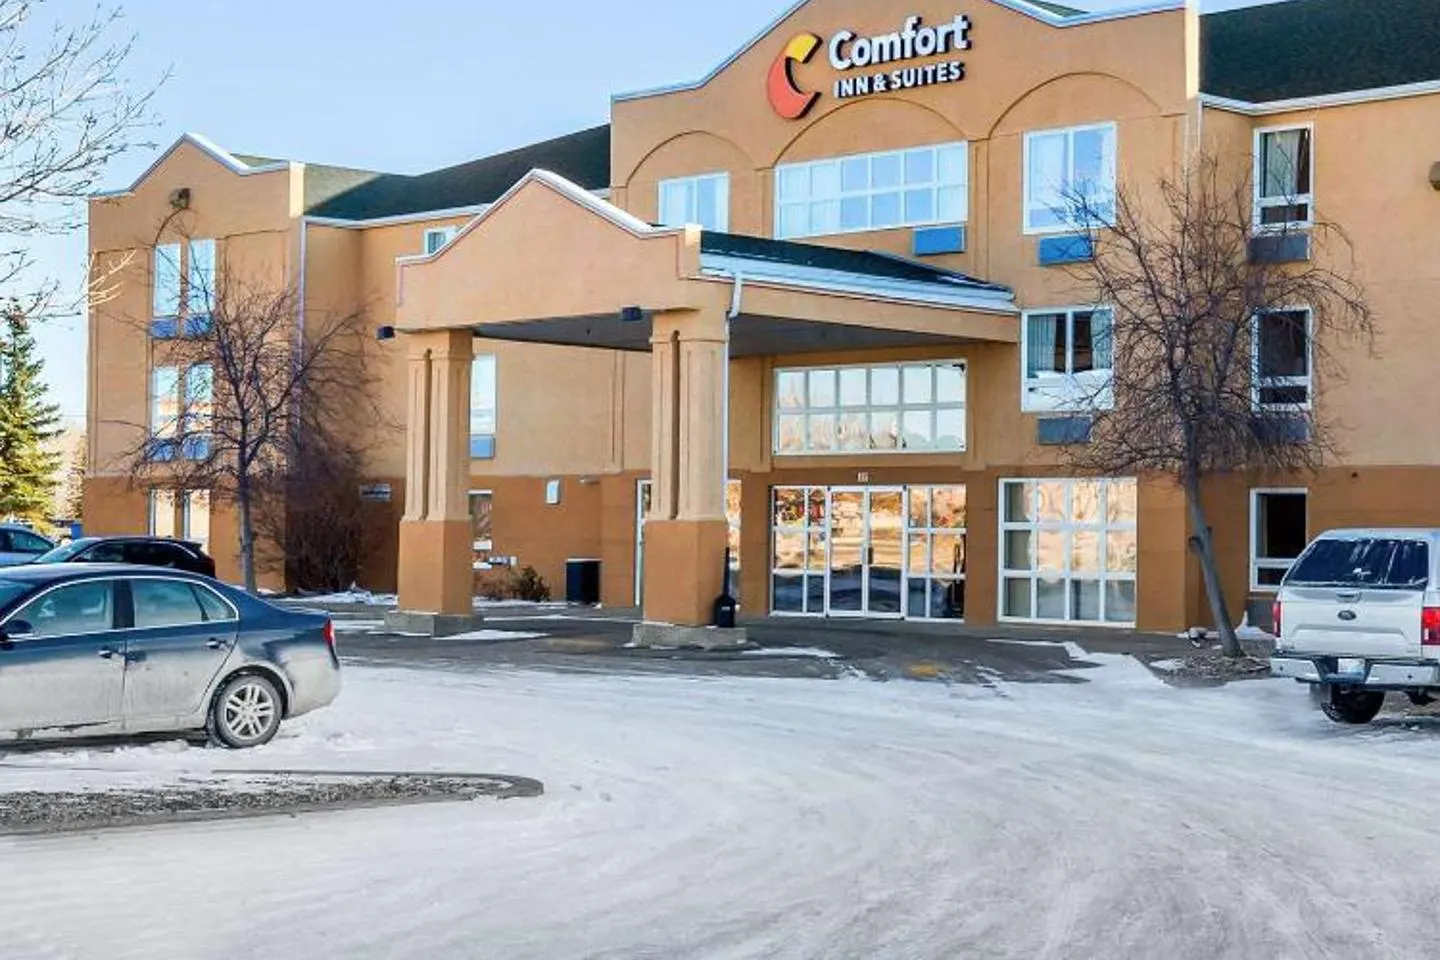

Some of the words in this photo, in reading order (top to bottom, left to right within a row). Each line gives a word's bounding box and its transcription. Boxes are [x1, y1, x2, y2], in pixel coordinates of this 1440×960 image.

[828, 15, 970, 70] Comfort
[833, 76, 869, 98] INN
[873, 73, 887, 91] &
[890, 60, 962, 89] SUITES
